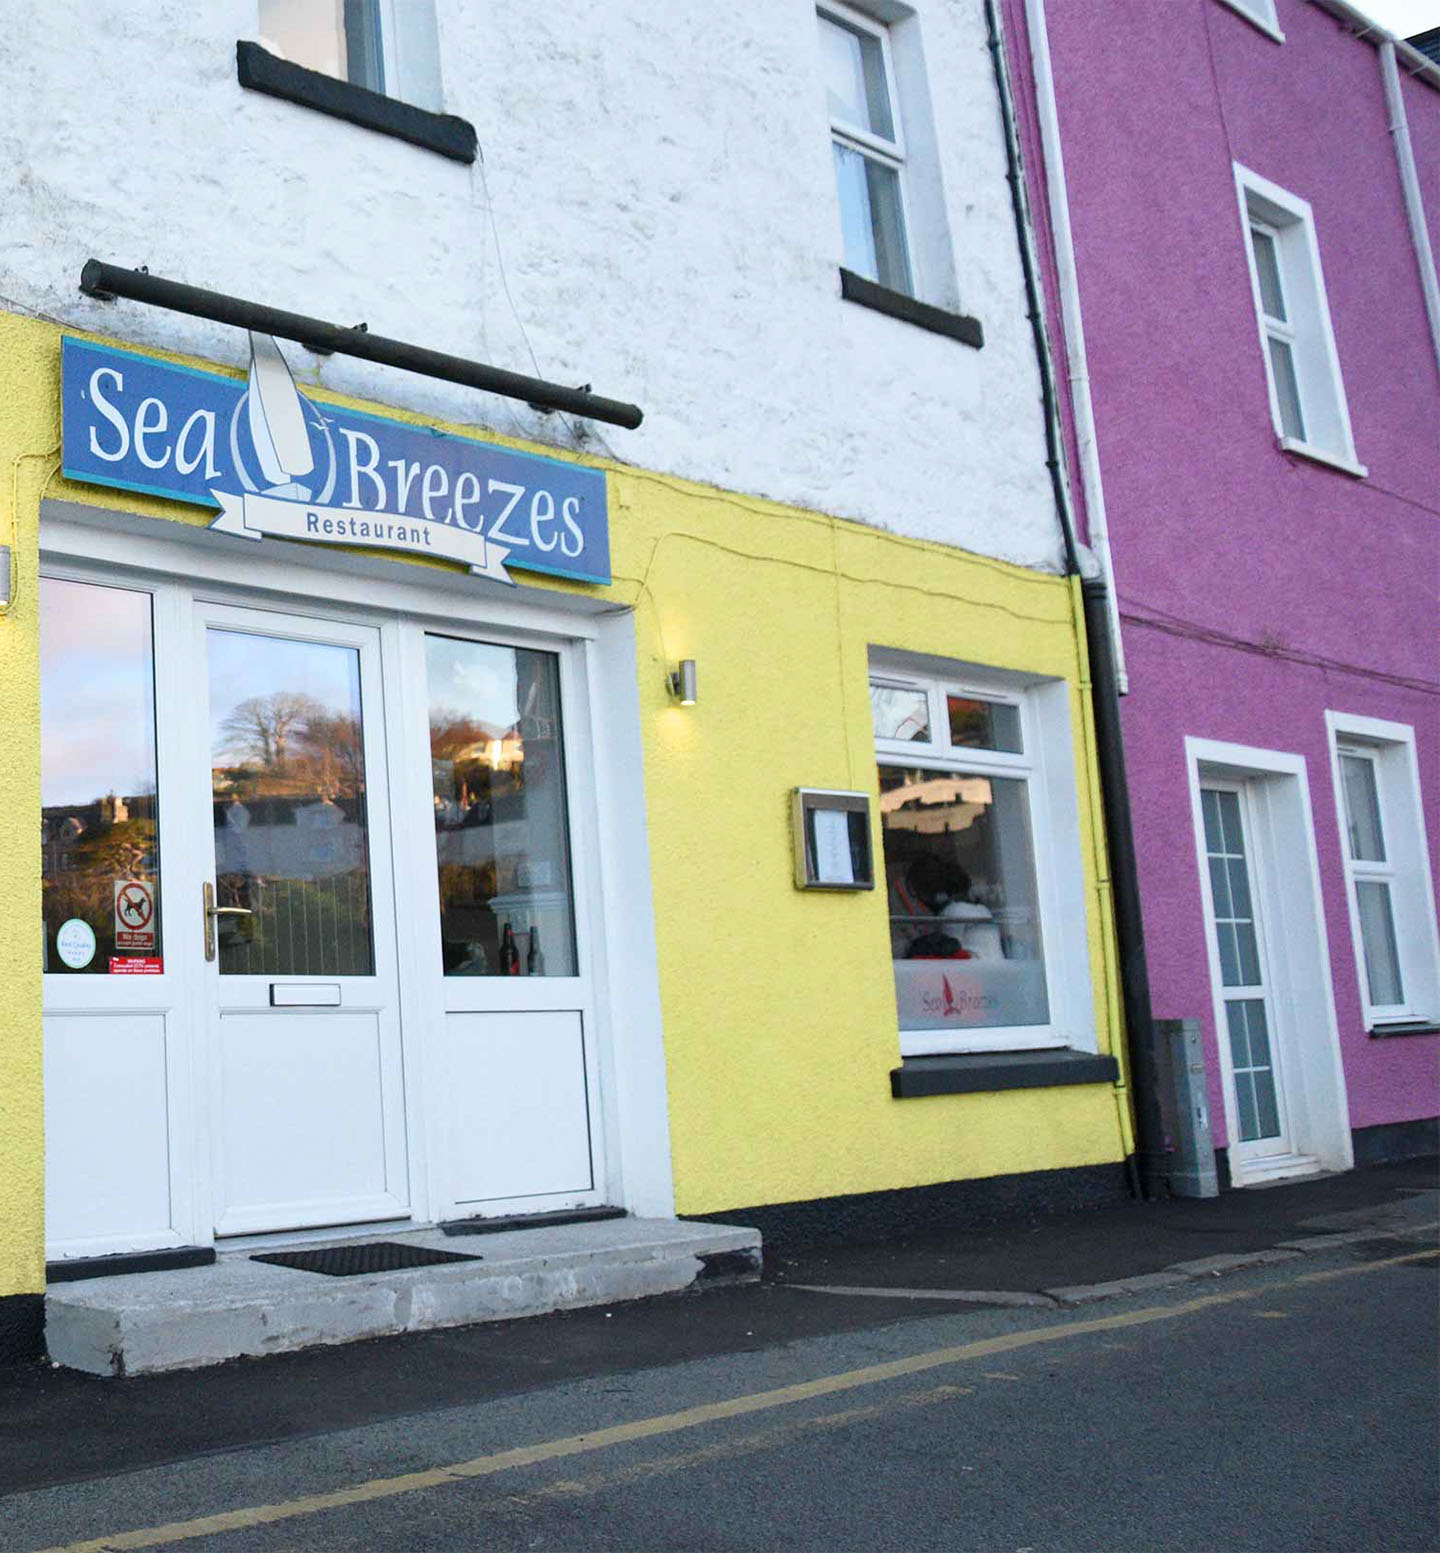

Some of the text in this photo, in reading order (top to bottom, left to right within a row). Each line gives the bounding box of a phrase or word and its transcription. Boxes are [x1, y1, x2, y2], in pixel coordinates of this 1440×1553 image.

[88, 366, 586, 559] Sea Breezes
[305, 511, 432, 547] Restaurant
